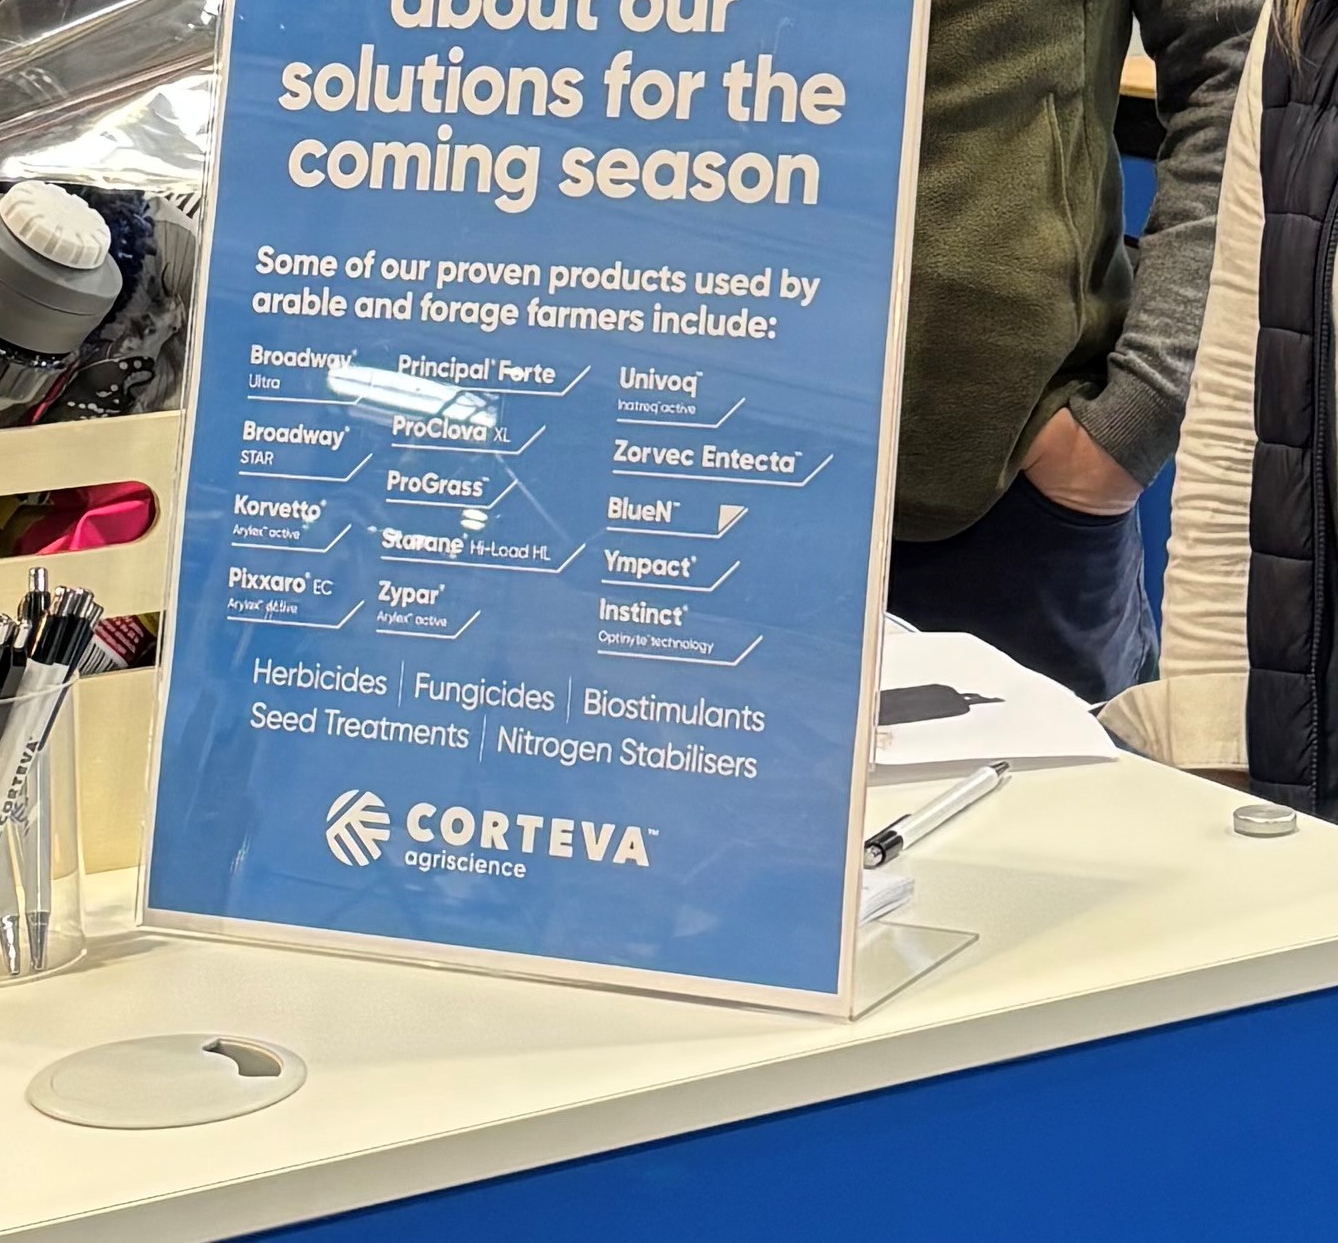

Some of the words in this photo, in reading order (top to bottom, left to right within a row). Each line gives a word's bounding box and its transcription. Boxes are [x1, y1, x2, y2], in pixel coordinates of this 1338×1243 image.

[279, 44, 584, 118] solutions
[603, 50, 706, 120] for
[723, 54, 846, 125] the
[288, 126, 540, 213] coming
[558, 145, 820, 206] season
[255, 245, 338, 275] Some
[344, 250, 376, 279] of
[380, 257, 431, 281] our
[437, 260, 541, 289] proven
[549, 261, 686, 295] products
[694, 267, 772, 298] used
[779, 268, 821, 307] by
[252, 286, 347, 317] arable
[354, 291, 413, 320] and
[420, 292, 519, 333] forage
[527, 297, 645, 333] farmers
[651, 302, 778, 339] include:
[248, 374, 281, 389] Ultra
[497, 360, 556, 385] Forte
[392, 415, 488, 442] ProClova
[493, 427, 512, 444] XL
[240, 450, 274, 466] STAR
[613, 439, 694, 468] Zorvec
[268, 527, 301, 541] active
[469, 540, 530, 560] Hi-Load
[532, 544, 552, 561] HL
[312, 578, 333, 596] EC
[414, 614, 448, 628] active
[650, 634, 714, 655] technology
[253, 657, 388, 696] Herbicides
[414, 671, 556, 713] Fungicides
[583, 688, 766, 733] Biostimulants
[250, 702, 316, 735] Seed
[324, 708, 470, 750] Treatments
[497, 724, 613, 768] Nitrogen
[620, 737, 758, 780] Stabilisers
[404, 849, 527, 880] agriscience
